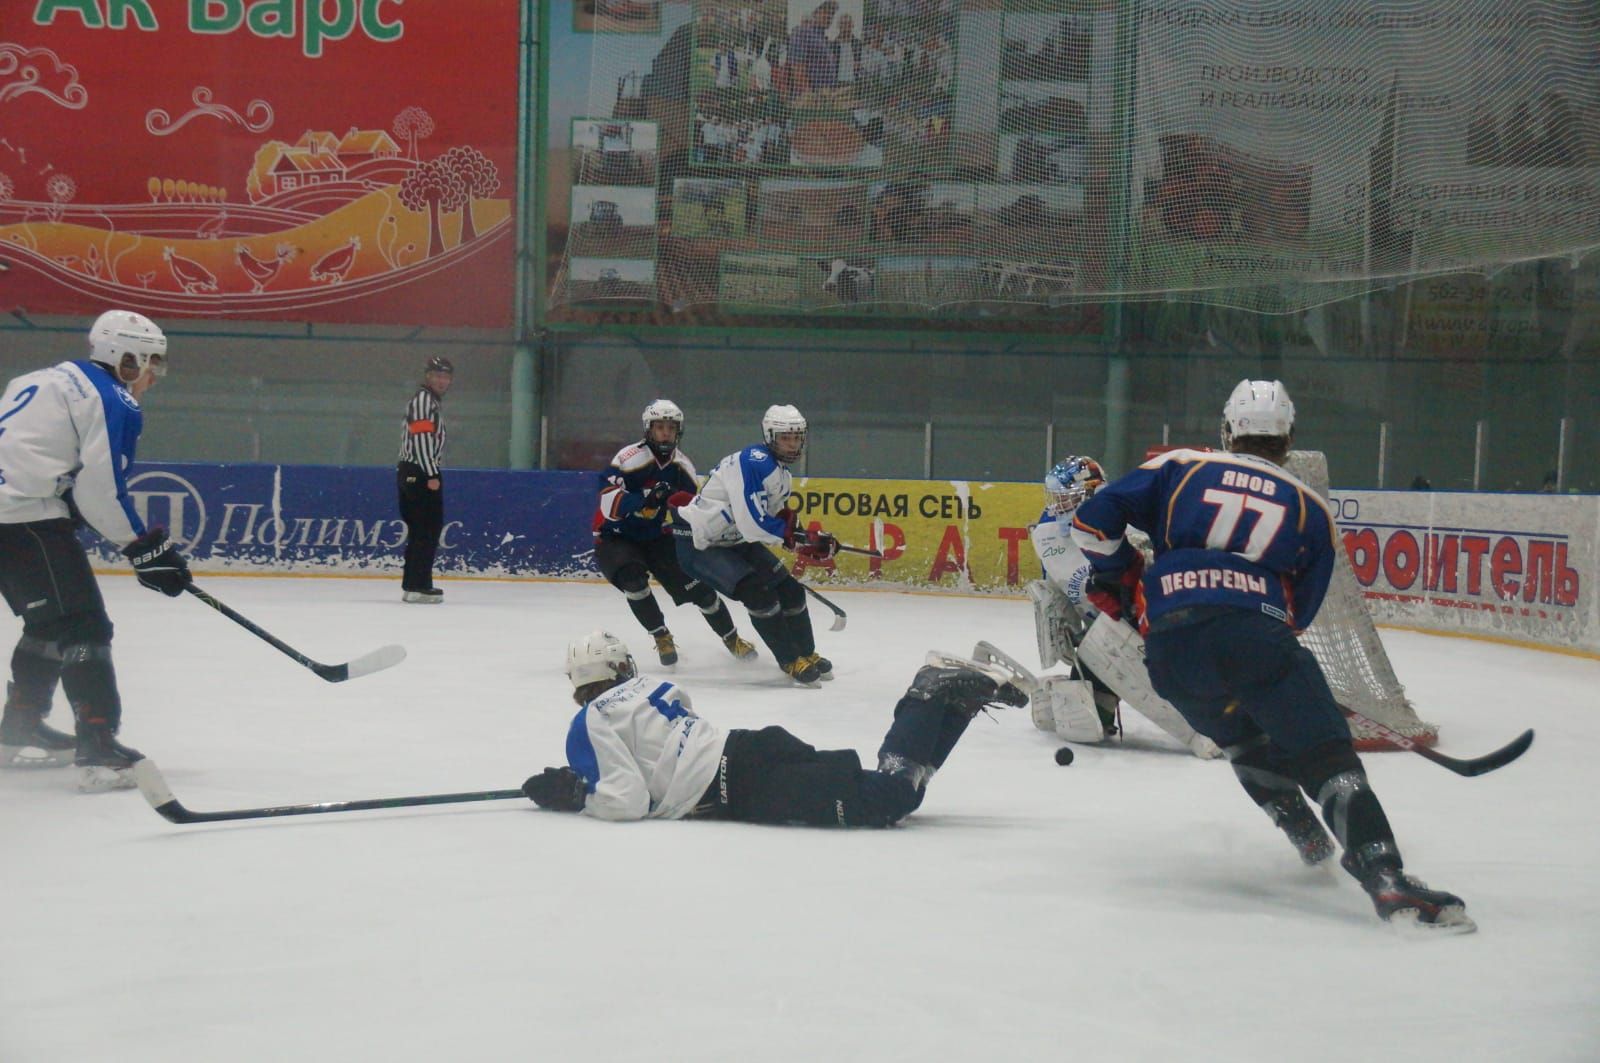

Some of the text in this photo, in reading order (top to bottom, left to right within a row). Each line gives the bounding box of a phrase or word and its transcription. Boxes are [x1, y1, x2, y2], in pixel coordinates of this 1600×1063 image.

[1200, 65, 1369, 86] ПРОИЗВОДСТВО
[1221, 470, 1277, 496] ЯНОВ
[784, 491, 909, 517] ОРГОВАЯ
[213, 503, 463, 548] Полимэс
[1203, 489, 1287, 562] 77
[133, 539, 171, 566] BAUE
[1341, 527, 1580, 608] роитель
[1160, 569, 1268, 595] ПЕСТРЕЦЫ
[720, 755, 728, 804] EASTON
